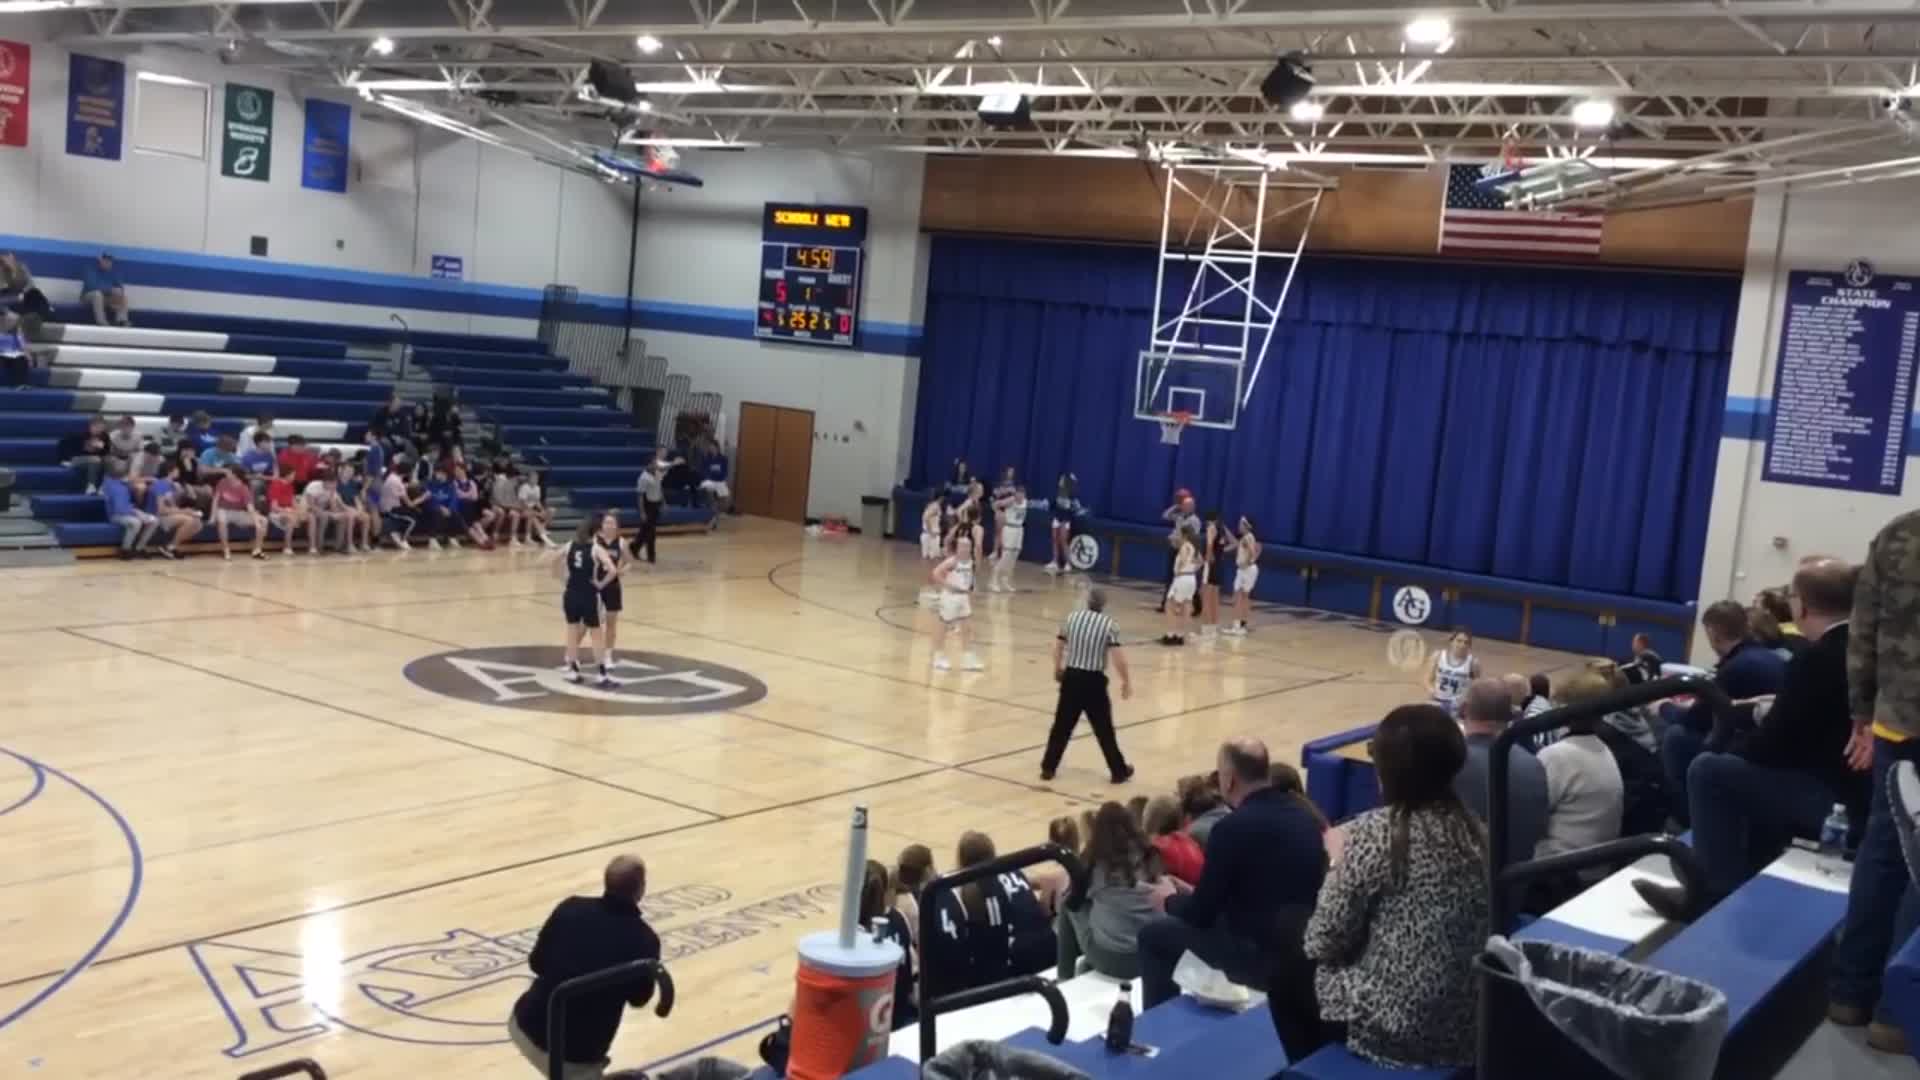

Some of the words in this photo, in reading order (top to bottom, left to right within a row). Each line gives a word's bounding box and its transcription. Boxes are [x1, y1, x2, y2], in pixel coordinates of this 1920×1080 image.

[1820, 295, 1892, 309] CHAMPION
[1836, 288, 1877, 299] STATE
[574, 549, 583, 568] 5
[1397, 588, 1425, 619] AG
[1439, 677, 1460, 694] 24
[941, 907, 958, 939] 4
